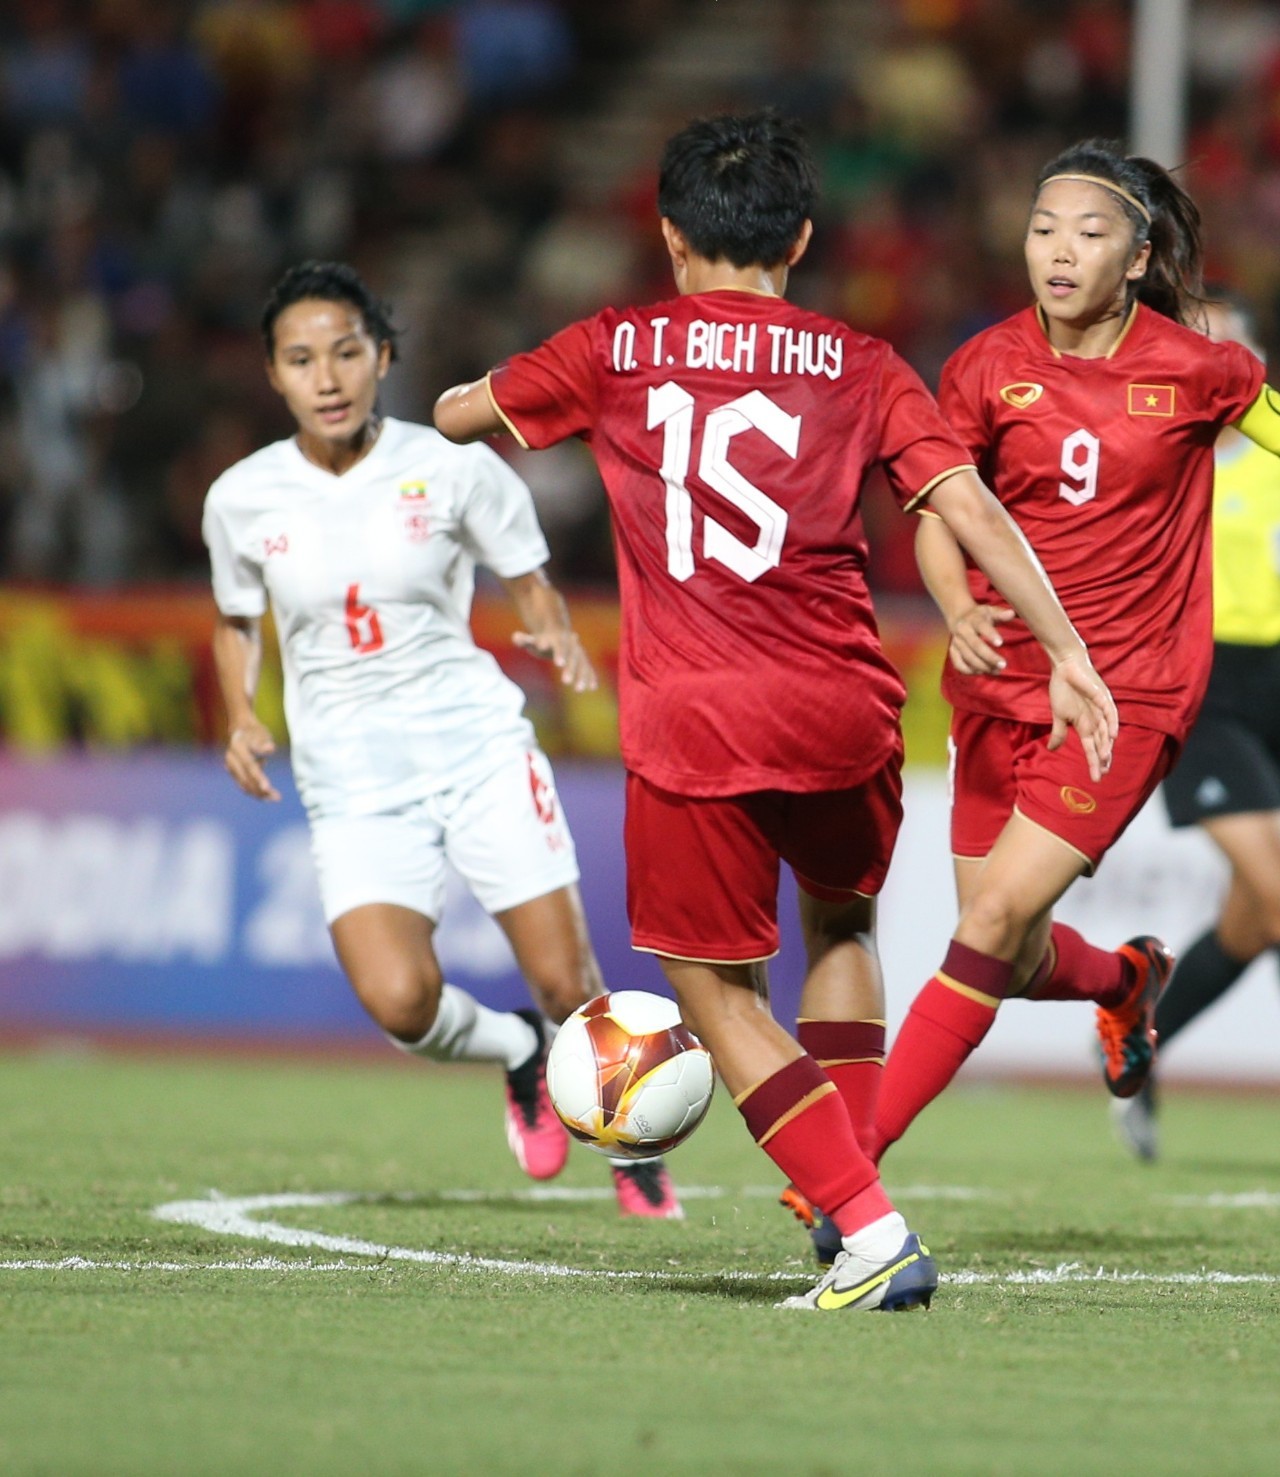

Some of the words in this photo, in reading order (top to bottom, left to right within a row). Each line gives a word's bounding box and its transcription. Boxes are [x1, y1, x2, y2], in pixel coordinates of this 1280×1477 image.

[650, 317, 675, 366] T.
[686, 320, 757, 373] BICH
[767, 325, 843, 380] THUY
[646, 380, 802, 583] 15
[1058, 428, 1100, 506] 9
[344, 583, 384, 654] 6
